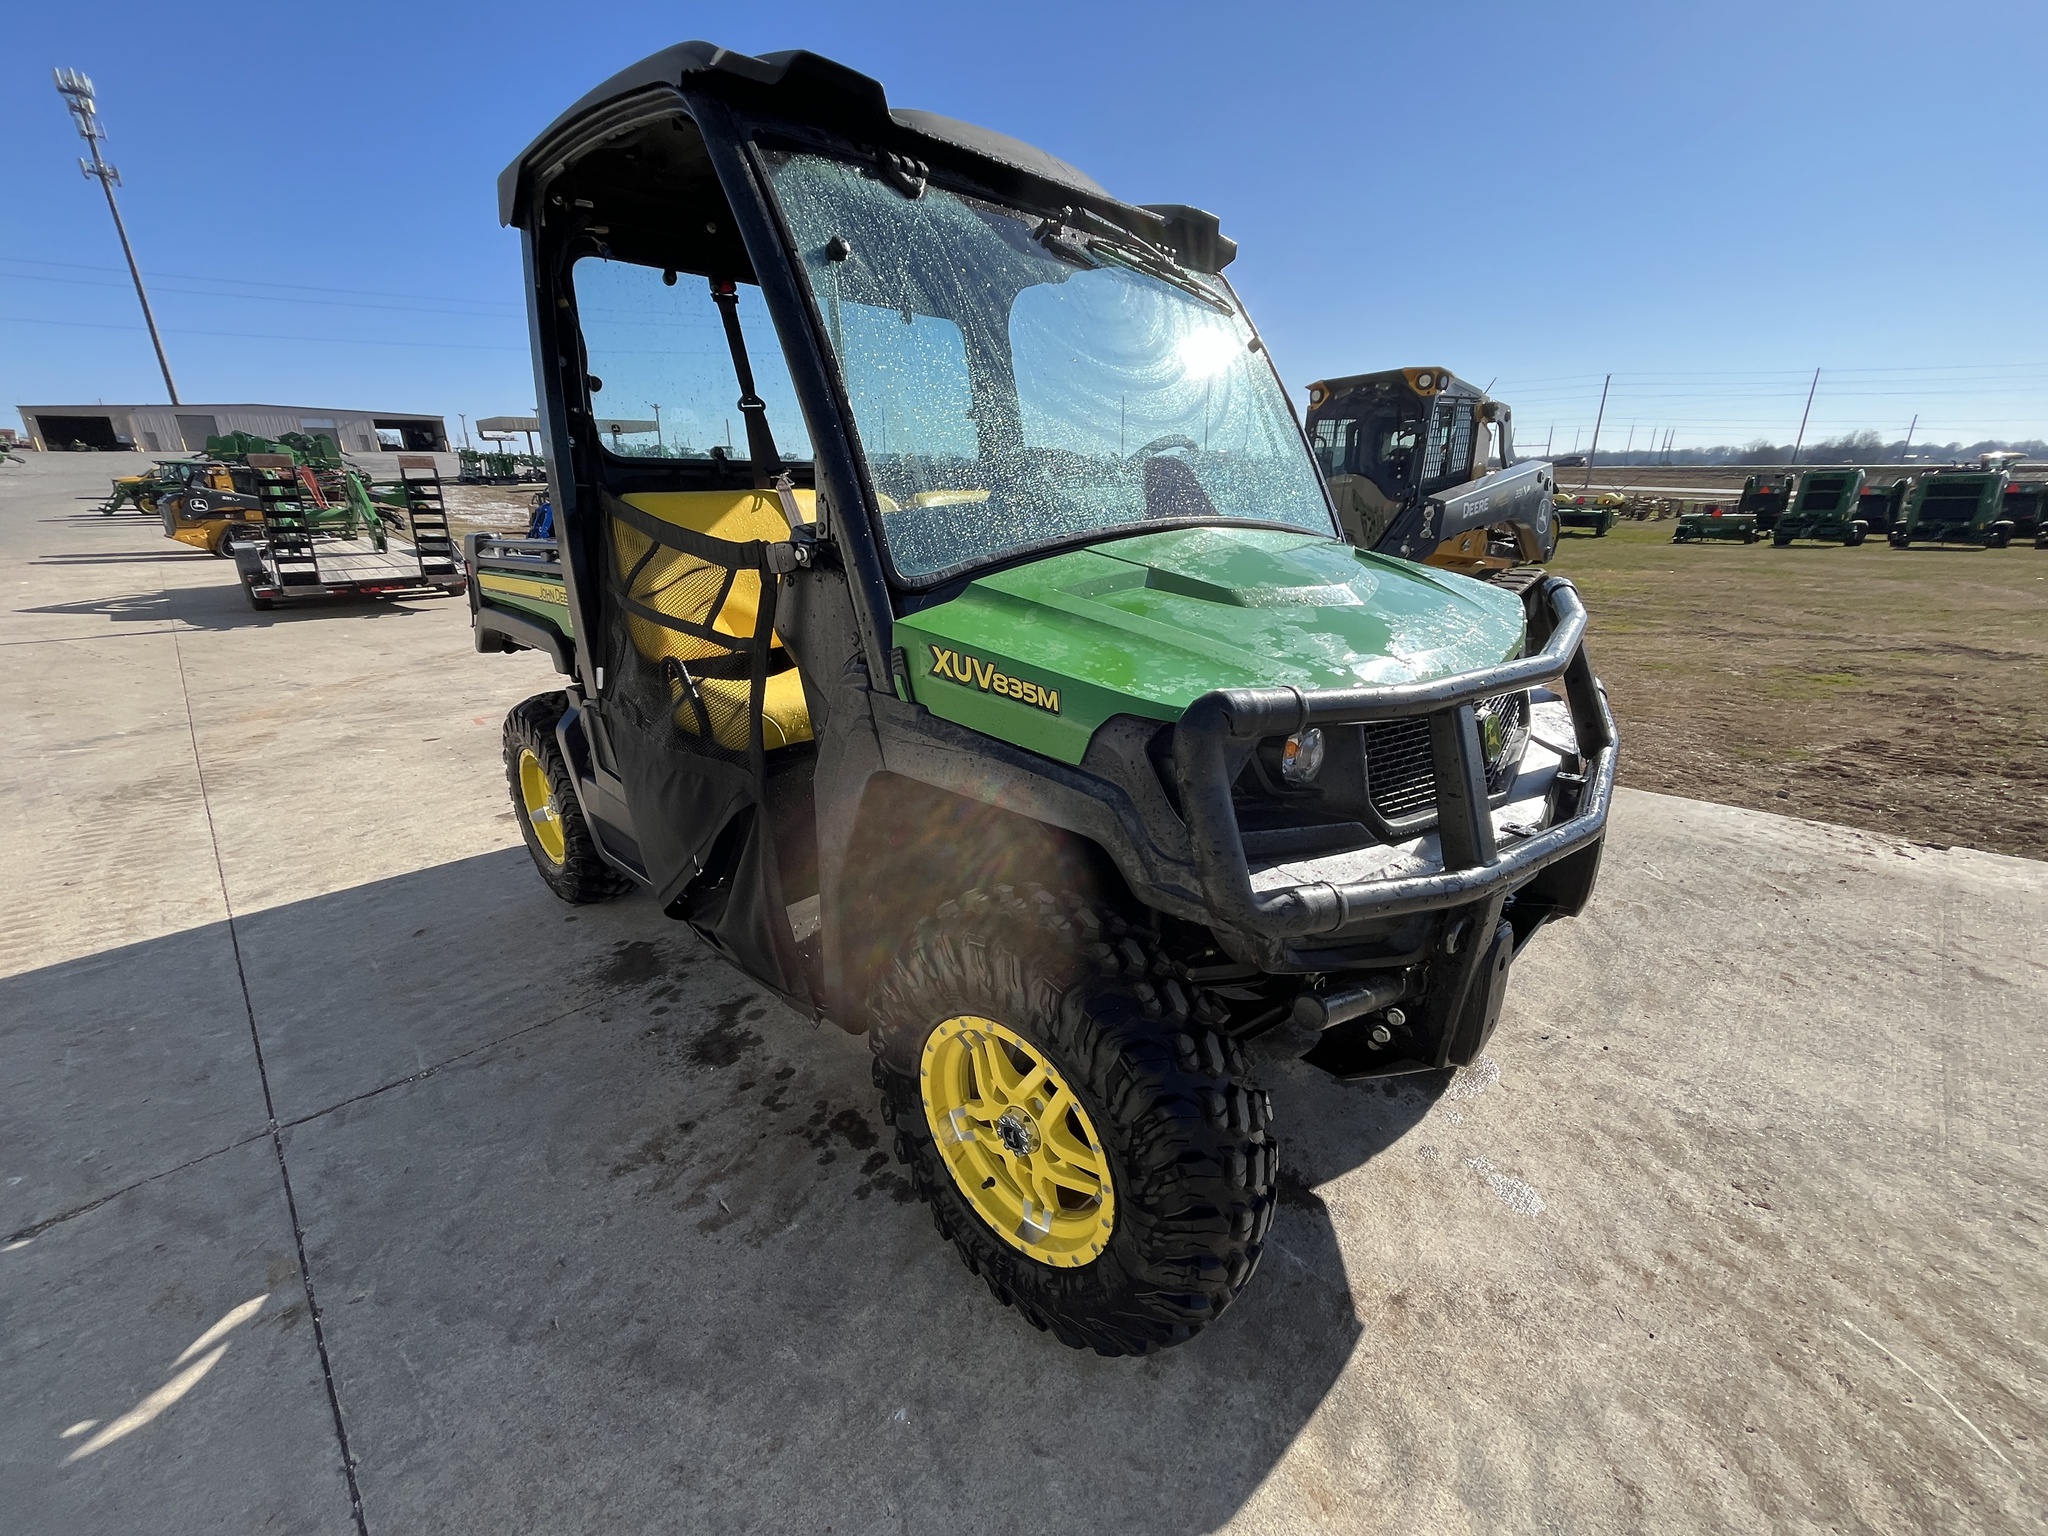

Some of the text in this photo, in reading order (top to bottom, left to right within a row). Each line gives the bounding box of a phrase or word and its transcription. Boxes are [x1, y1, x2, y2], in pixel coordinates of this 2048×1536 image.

[1462, 497, 1489, 519] DEERE
[539, 586, 555, 602] JOHN
[931, 645, 1060, 712] XUV835M
